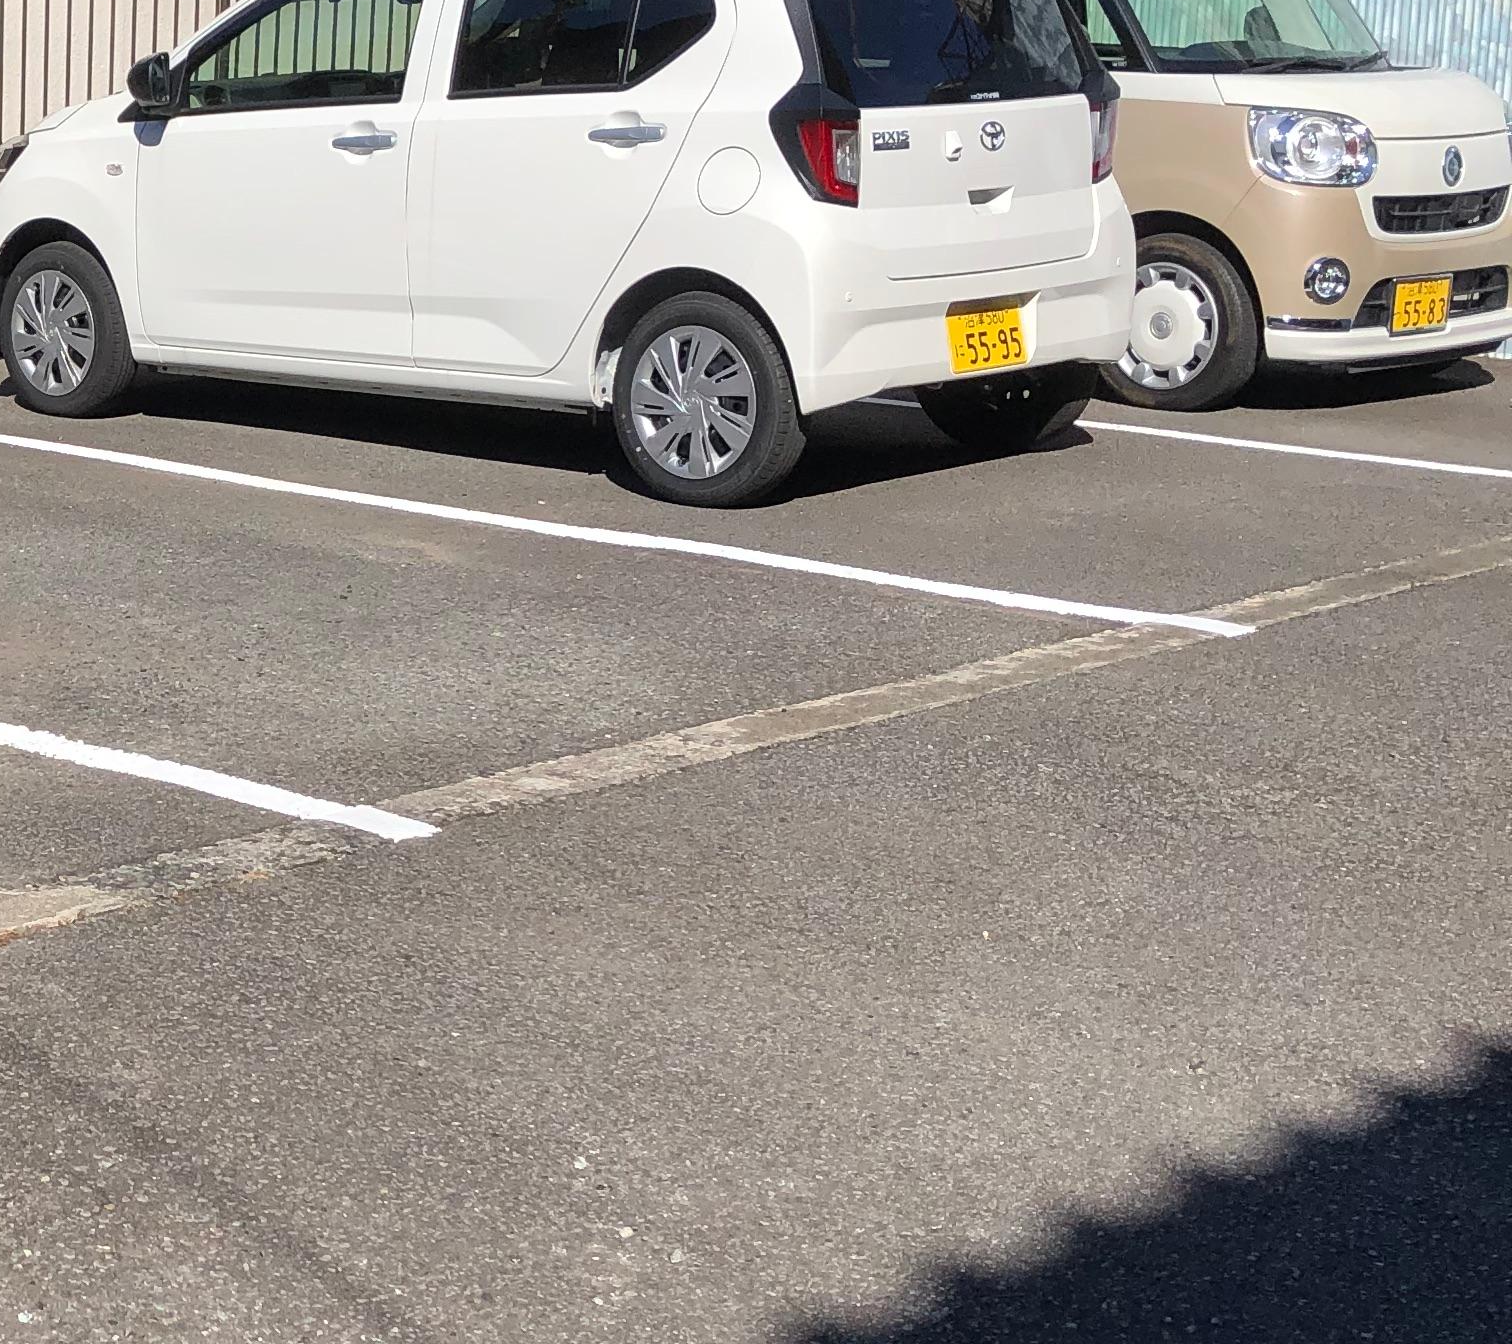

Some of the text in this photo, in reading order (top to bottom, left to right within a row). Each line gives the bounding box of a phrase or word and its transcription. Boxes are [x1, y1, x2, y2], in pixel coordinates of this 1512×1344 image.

[872, 130, 910, 145] PIXIS
[1402, 297, 1446, 328] 55-83
[965, 326, 1023, 365] 55-95
